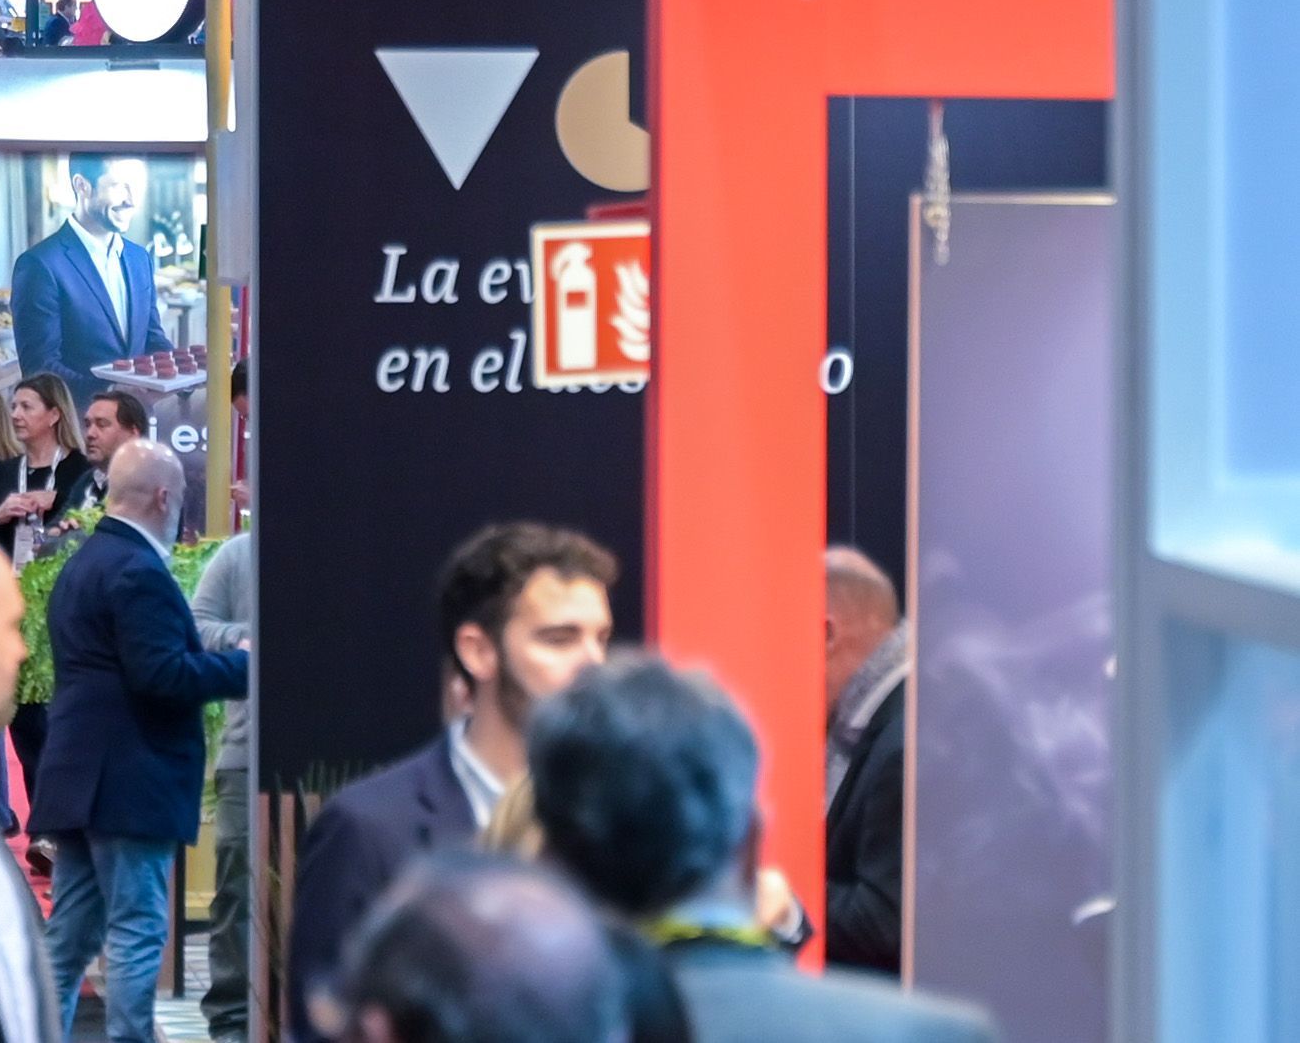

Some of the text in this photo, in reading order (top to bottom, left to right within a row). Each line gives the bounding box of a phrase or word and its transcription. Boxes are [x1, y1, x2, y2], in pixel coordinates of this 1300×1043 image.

[374, 245, 461, 304] La
[376, 330, 528, 393] en el
